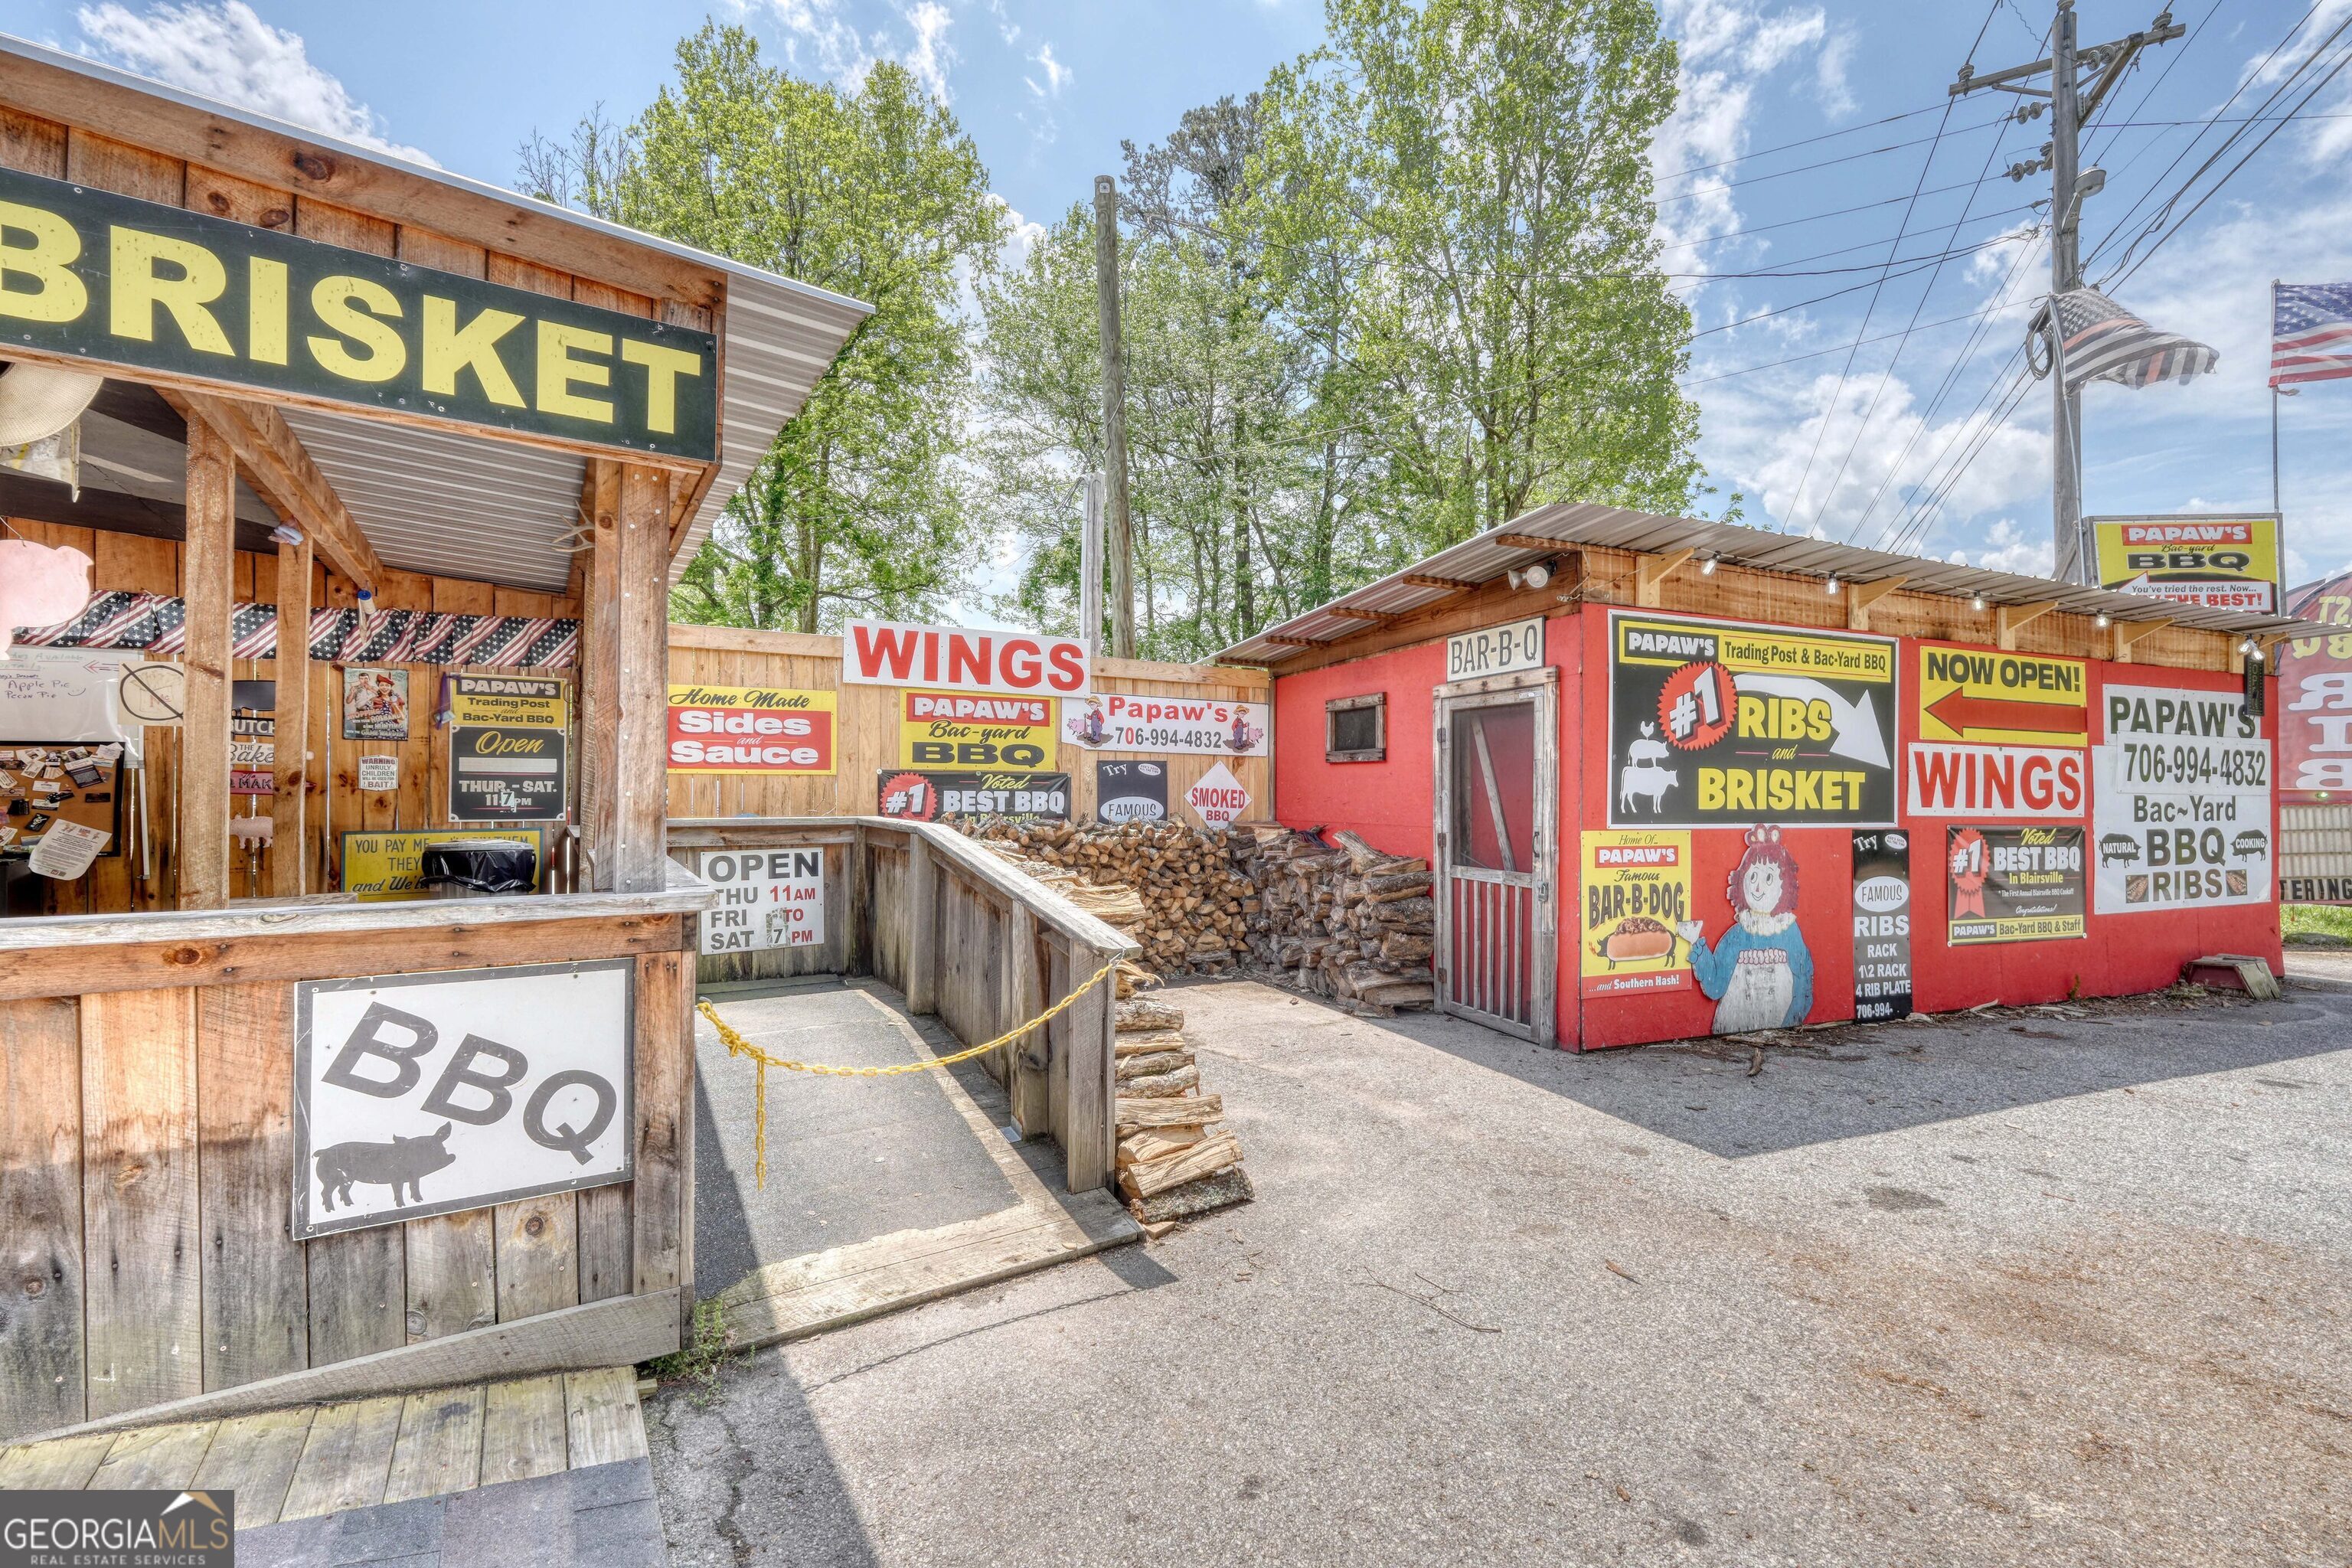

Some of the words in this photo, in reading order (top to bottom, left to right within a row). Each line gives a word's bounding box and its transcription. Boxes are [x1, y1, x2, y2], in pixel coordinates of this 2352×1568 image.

[0, 200, 701, 435] BRISKET
[2128, 526, 2247, 541] PAPAW'S
[2161, 544, 2216, 555] Bac-yard
[2127, 552, 2250, 572] BBQ
[2207, 593, 2262, 606] BEST!
[853, 626, 1084, 691] WINGS
[1451, 624, 1538, 675] BAR-B-Q
[1628, 632, 1714, 656] PAPAW'S
[1725, 641, 1769, 665] Trading
[1771, 644, 1797, 664] Post
[1801, 648, 1811, 665] &
[1814, 648, 1860, 668] Bac-Yard
[1864, 654, 1886, 672] BBQ
[1928, 652, 1994, 684] NOW
[2000, 658, 2080, 692] OPEN!
[8, 680, 44, 691] Apple
[461, 680, 556, 696] PAPAW'S
[468, 697, 518, 708] Trading
[521, 699, 550, 708] Post
[669, 688, 737, 707] Home
[744, 690, 810, 708] Made
[1669, 666, 1720, 740] #1
[462, 713, 523, 723] Bac-Yard
[527, 714, 554, 724] BBQ
[914, 697, 1044, 721] PAPAW'S
[1109, 696, 1229, 724] Papaw's
[1738, 696, 1832, 741] RIBS
[2110, 696, 2256, 739] PAPAW'S
[231, 720, 275, 733] UTC
[679, 710, 812, 736] Sides
[929, 720, 1031, 745] Bac-yard
[475, 730, 544, 756] Open
[737, 736, 762, 746] and
[1115, 727, 1222, 749] 706-994-4832
[671, 740, 818, 764] Sauce
[912, 742, 1045, 768] BBQ
[1772, 744, 1798, 760] and
[1102, 763, 1128, 776] Try
[2124, 743, 2266, 786] 706-994-4832
[459, 780, 510, 792] THUR.
[523, 781, 557, 792] SAT.
[981, 774, 1031, 790] Voted
[1698, 767, 1866, 811] BRISKET
[1913, 750, 2082, 811] WINGS
[886, 782, 926, 813] #1
[943, 790, 1009, 812] BEST
[1014, 791, 1064, 814] BBQ
[1191, 787, 1246, 809] SMOKED
[1109, 802, 1157, 817] FAMOUS
[1206, 810, 1230, 822] BBQ
[355, 839, 378, 853] YOU
[385, 839, 406, 853] PAY
[1619, 835, 1643, 845] Home
[1854, 835, 1877, 851] Try
[2020, 828, 2057, 845] Voted
[2236, 838, 2265, 850] COOKING
[1599, 848, 1675, 864] PAPAW'S
[1953, 839, 1981, 874] #1
[2102, 841, 2136, 854] NATURAL
[2146, 827, 2226, 867] BBQ
[387, 858, 420, 871] THEY
[707, 851, 819, 883] OPEN
[1994, 847, 2041, 871] BEST
[2044, 846, 2081, 871] BBQ
[352, 879, 386, 892] and
[1614, 870, 1661, 883] Famous
[2009, 873, 2018, 884] In
[2020, 871, 2064, 884] Blairsville
[2153, 869, 2223, 901] RIBS
[1861, 884, 1903, 902] FAMOUS
[1589, 882, 1684, 931] BAR-B-DOG
[2015, 903, 2058, 917] Congratulations!
[710, 910, 747, 928] FRI
[784, 908, 804, 923] TO
[1854, 914, 1909, 937] RIBS
[1954, 925, 1995, 936] PAPAW'S
[2000, 922, 2037, 935] Bac-Yard
[2038, 921, 2053, 933] BBQ
[2055, 920, 2061, 931] &
[2063, 919, 2081, 931] Staff
[710, 930, 754, 950] SAT
[773, 928, 783, 943] 7
[792, 929, 813, 943] PM
[1867, 943, 1897, 959] RACK
[1877, 963, 1906, 977] RACK
[1614, 978, 1654, 991] Southern
[1655, 974, 1680, 988] Hash!
[1856, 983, 1862, 997] 4
[1864, 982, 1880, 997] RIB
[1883, 980, 1911, 995] PLATE
[320, 1001, 617, 1166] BBQ
